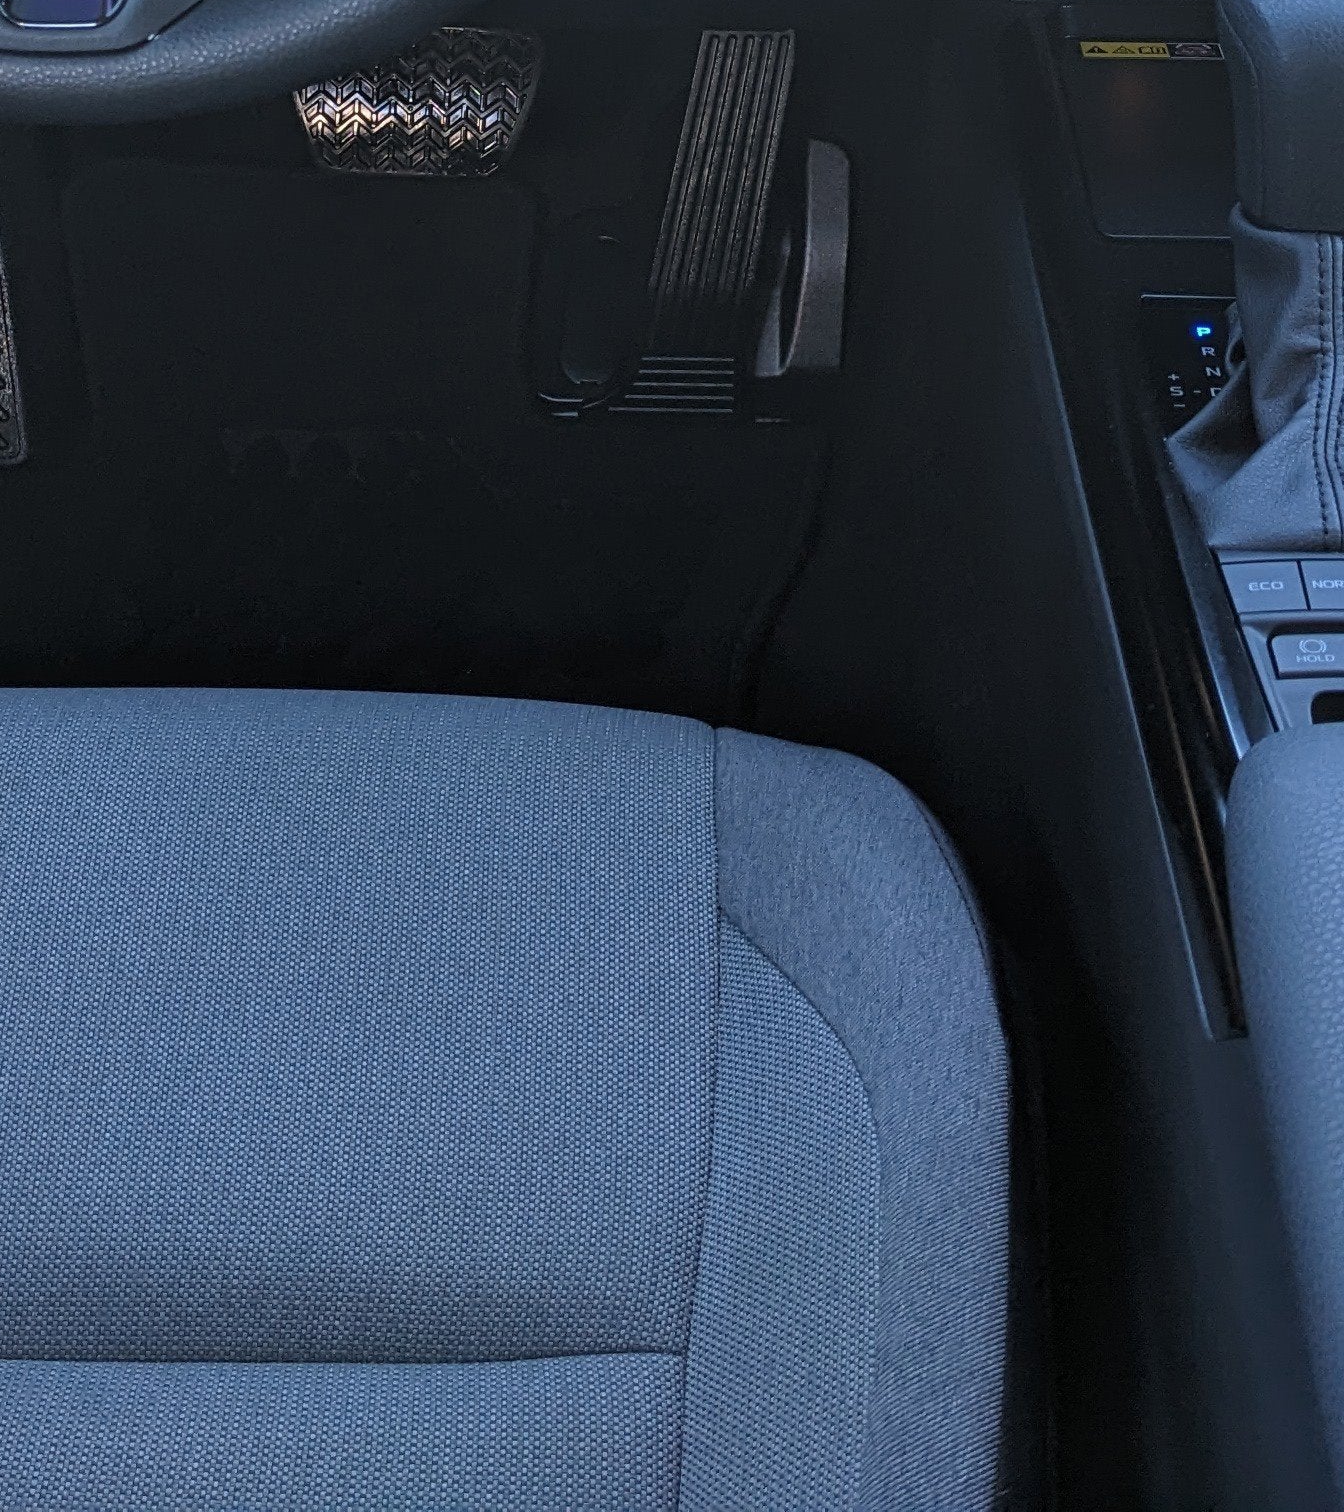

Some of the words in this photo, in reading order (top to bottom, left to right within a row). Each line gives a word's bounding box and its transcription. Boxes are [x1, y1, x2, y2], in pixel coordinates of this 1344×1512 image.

[1196, 326, 1211, 337] P
[1201, 347, 1216, 357] R
[1205, 366, 1221, 377] N
[1169, 386, 1184, 396] S
[1248, 580, 1284, 592] ECO
[1295, 654, 1336, 664] HOLD
